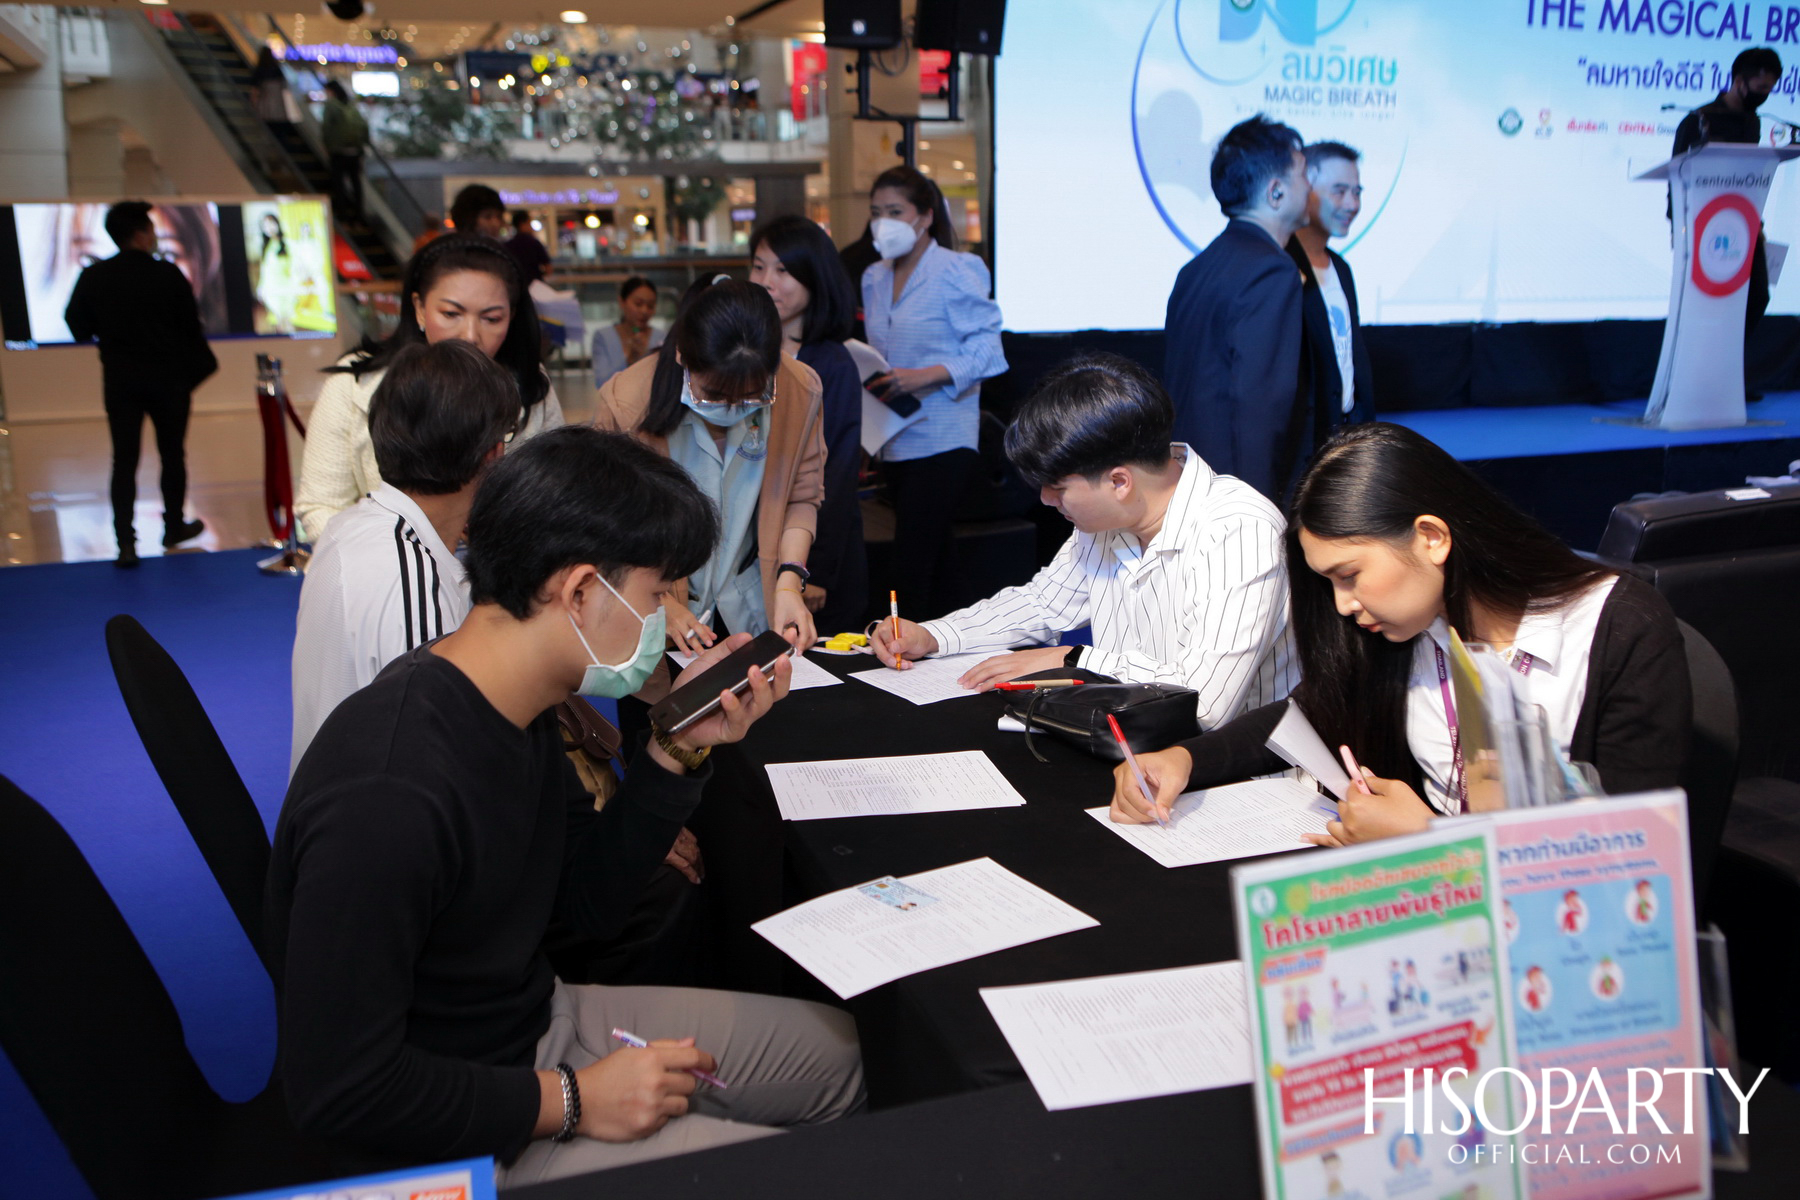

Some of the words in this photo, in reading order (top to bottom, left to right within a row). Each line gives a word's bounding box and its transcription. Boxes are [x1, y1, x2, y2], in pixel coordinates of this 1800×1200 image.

[1598, 0, 1752, 42] MAGICAL
[1264, 86, 1323, 105] MAGIC
[1328, 87, 1397, 108] BREATH
